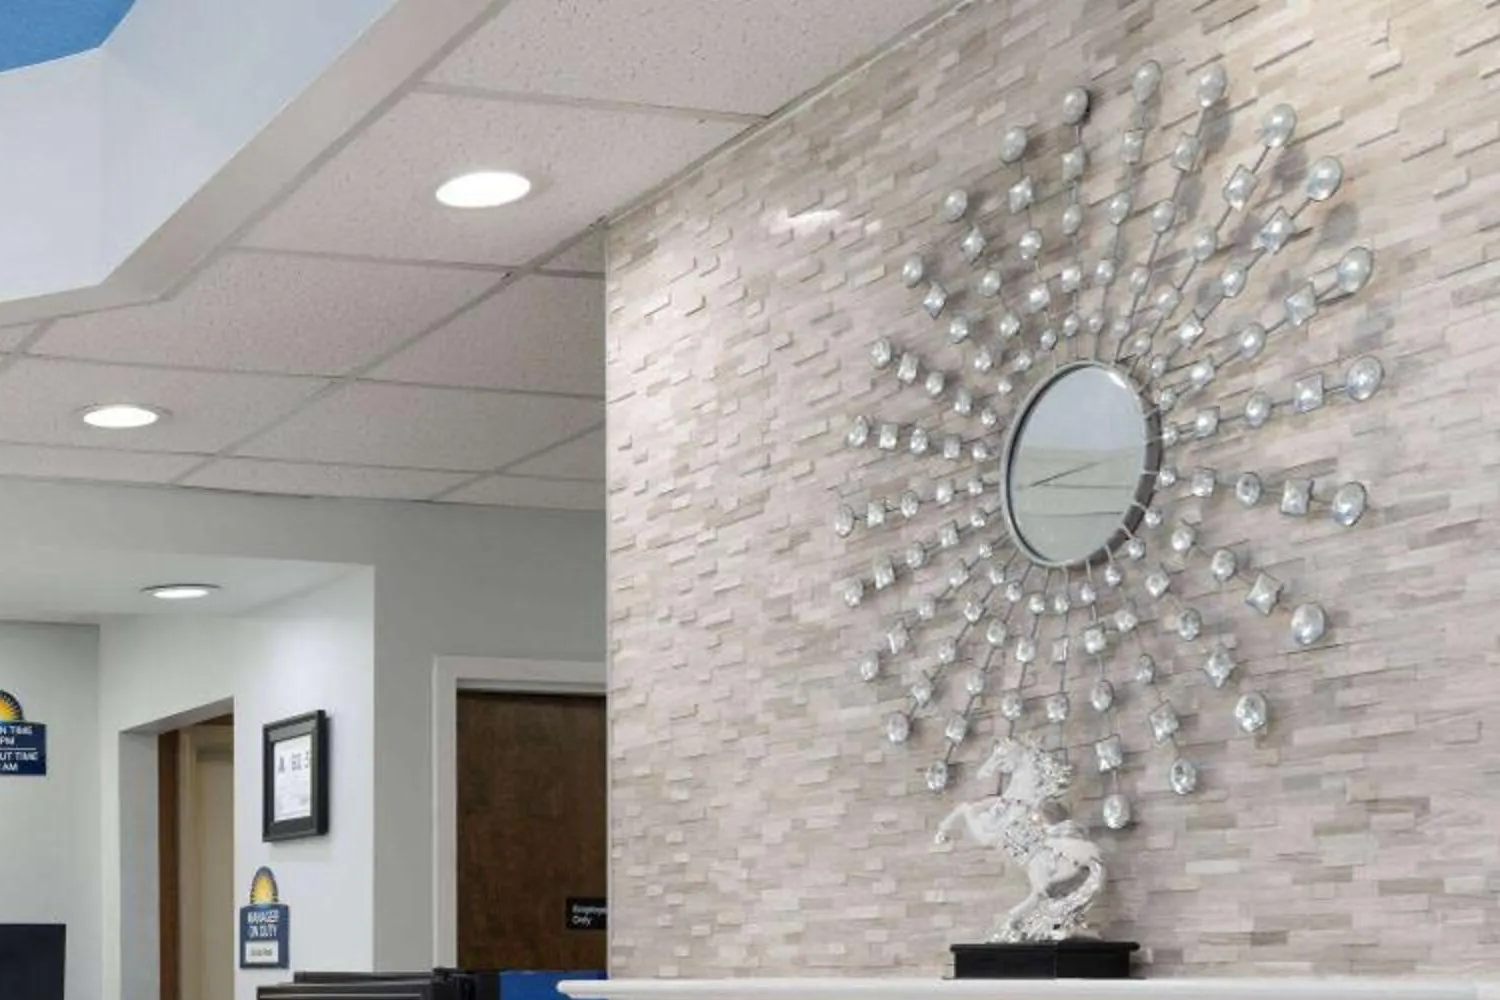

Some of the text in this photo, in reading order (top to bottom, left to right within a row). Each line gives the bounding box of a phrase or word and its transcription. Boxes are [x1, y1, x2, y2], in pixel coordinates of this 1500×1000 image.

[9, 725, 33, 735] TIME
[0, 736, 15, 745] PM
[15, 752, 39, 761] TIME
[3, 762, 19, 772] AM
